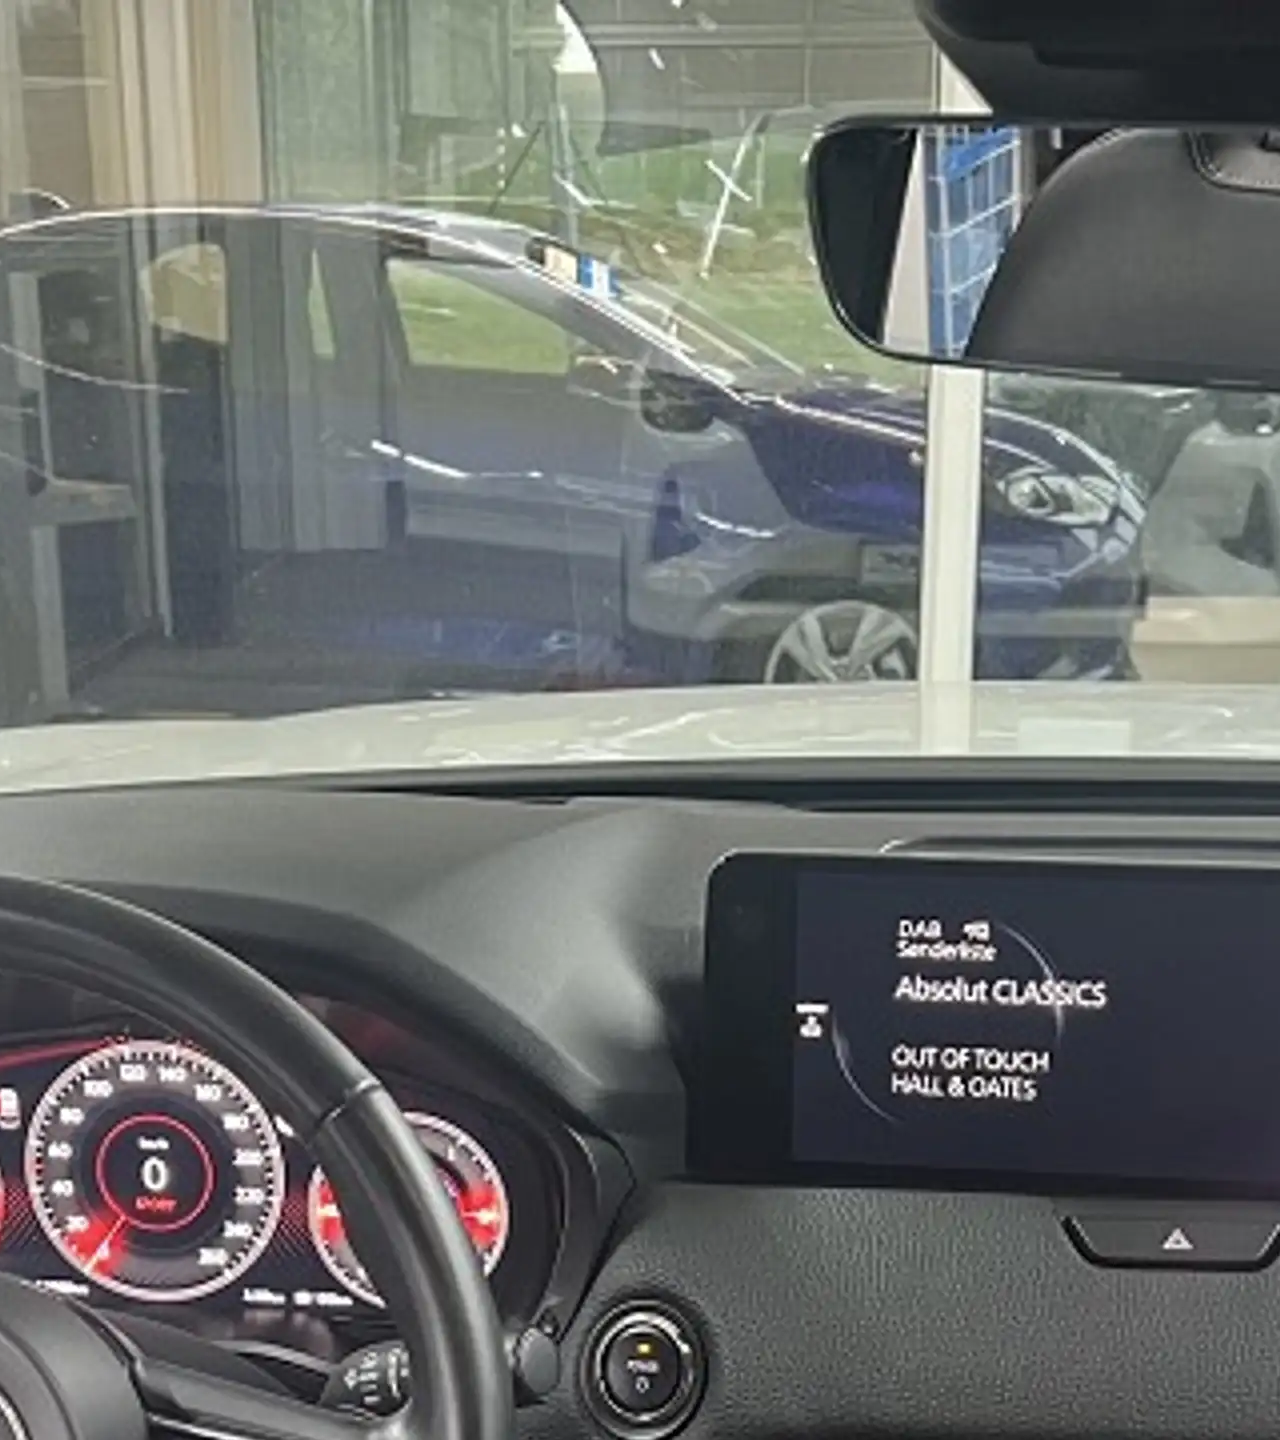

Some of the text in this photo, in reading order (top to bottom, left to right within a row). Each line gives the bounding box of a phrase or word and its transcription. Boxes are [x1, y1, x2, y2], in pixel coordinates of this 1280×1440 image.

[898, 919, 942, 939] DAB
[893, 973, 1108, 1008] Absolut CLASSICS
[891, 1043, 1051, 1074] OUT OF TOUCH
[891, 1072, 946, 1098] HALL
[947, 1076, 966, 1099] &
[141, 1156, 168, 1193] 0
